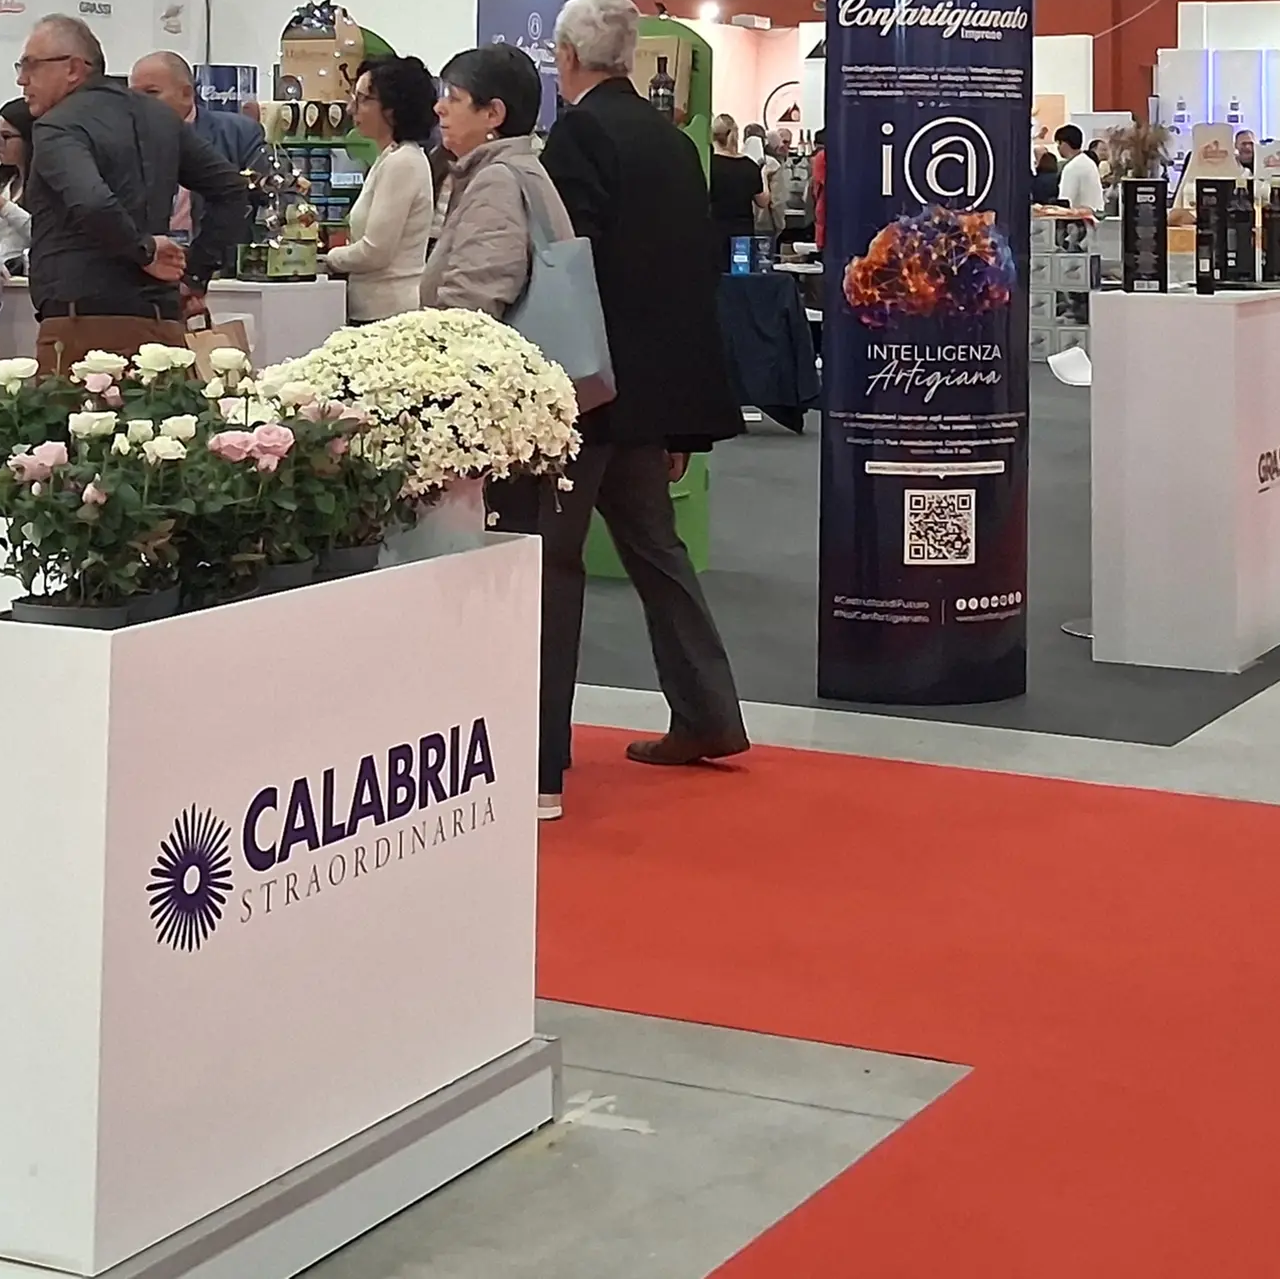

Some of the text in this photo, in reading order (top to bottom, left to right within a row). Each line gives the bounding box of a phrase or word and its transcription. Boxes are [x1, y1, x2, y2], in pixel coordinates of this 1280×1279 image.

[865, 360, 1002, 403] Artigiana
[867, 344, 1002, 362] INTELLIGENZA
[242, 716, 496, 872] CALABRIA
[239, 797, 496, 923] STRAORDINARIA
